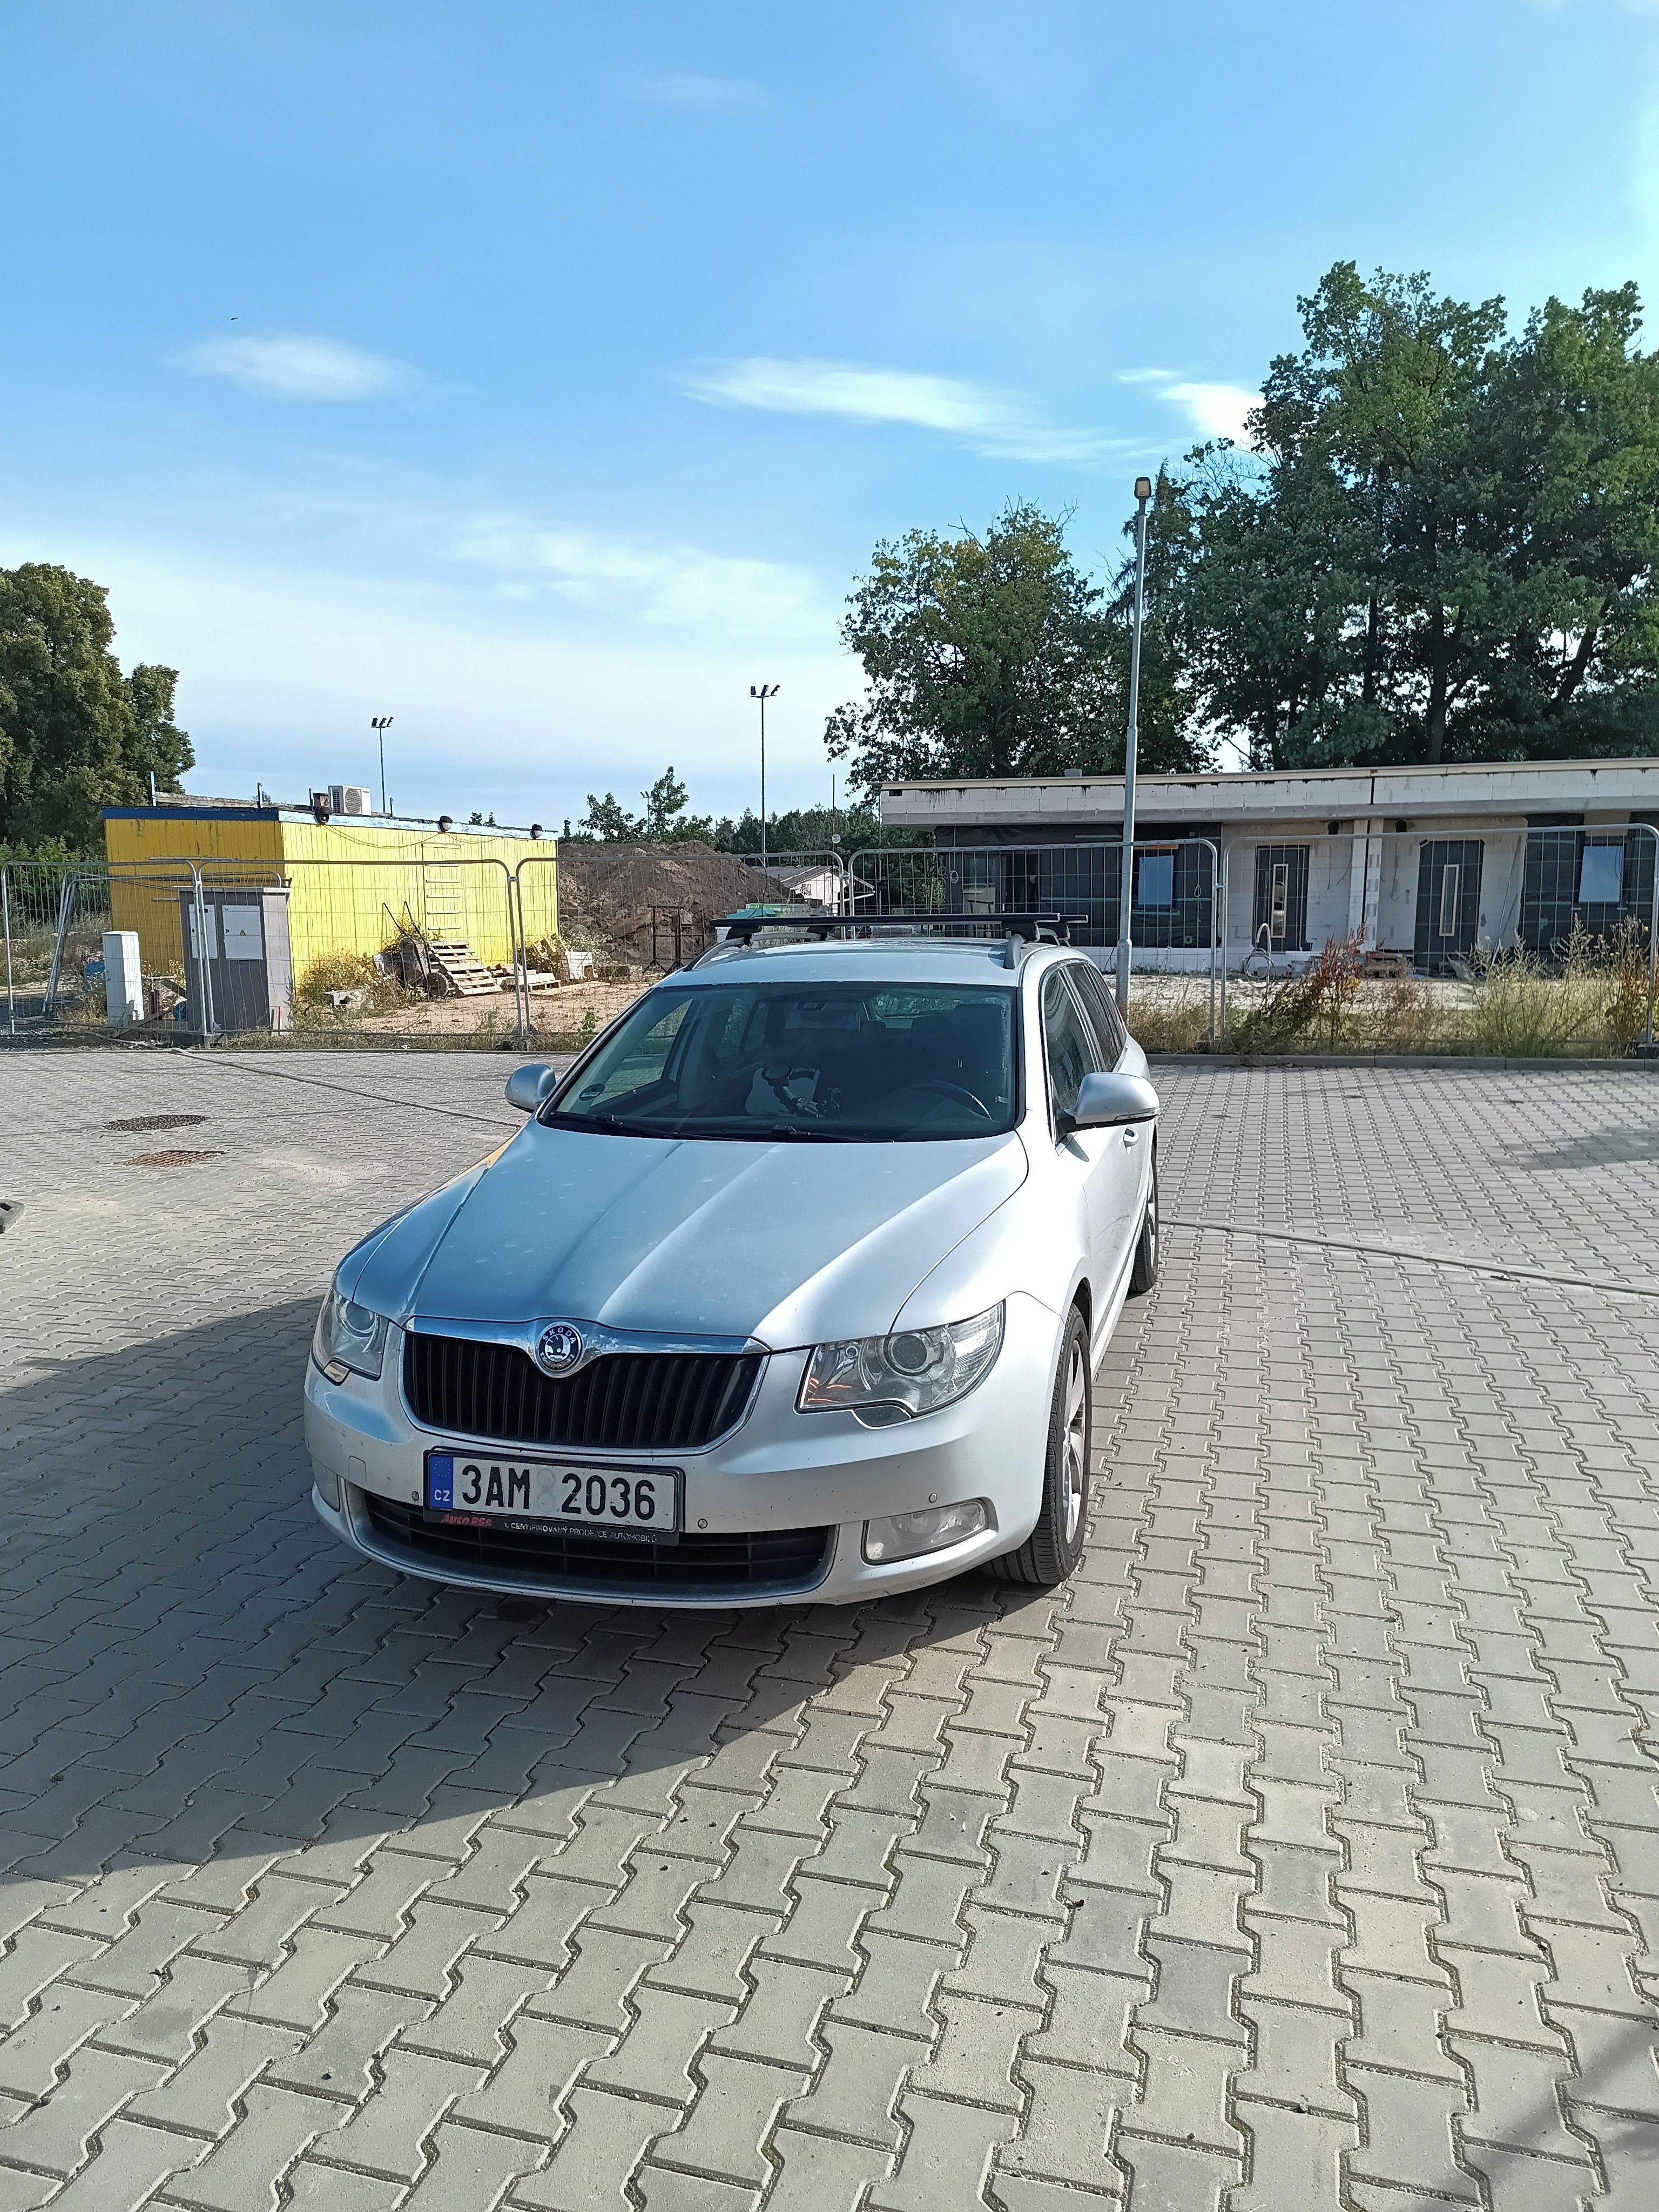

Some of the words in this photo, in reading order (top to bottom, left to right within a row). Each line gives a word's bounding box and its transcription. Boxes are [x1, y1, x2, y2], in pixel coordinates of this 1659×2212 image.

[434, 1489, 450, 1502] CZ
[461, 1465, 530, 1509] 3AM
[561, 1473, 656, 1520] 2036
